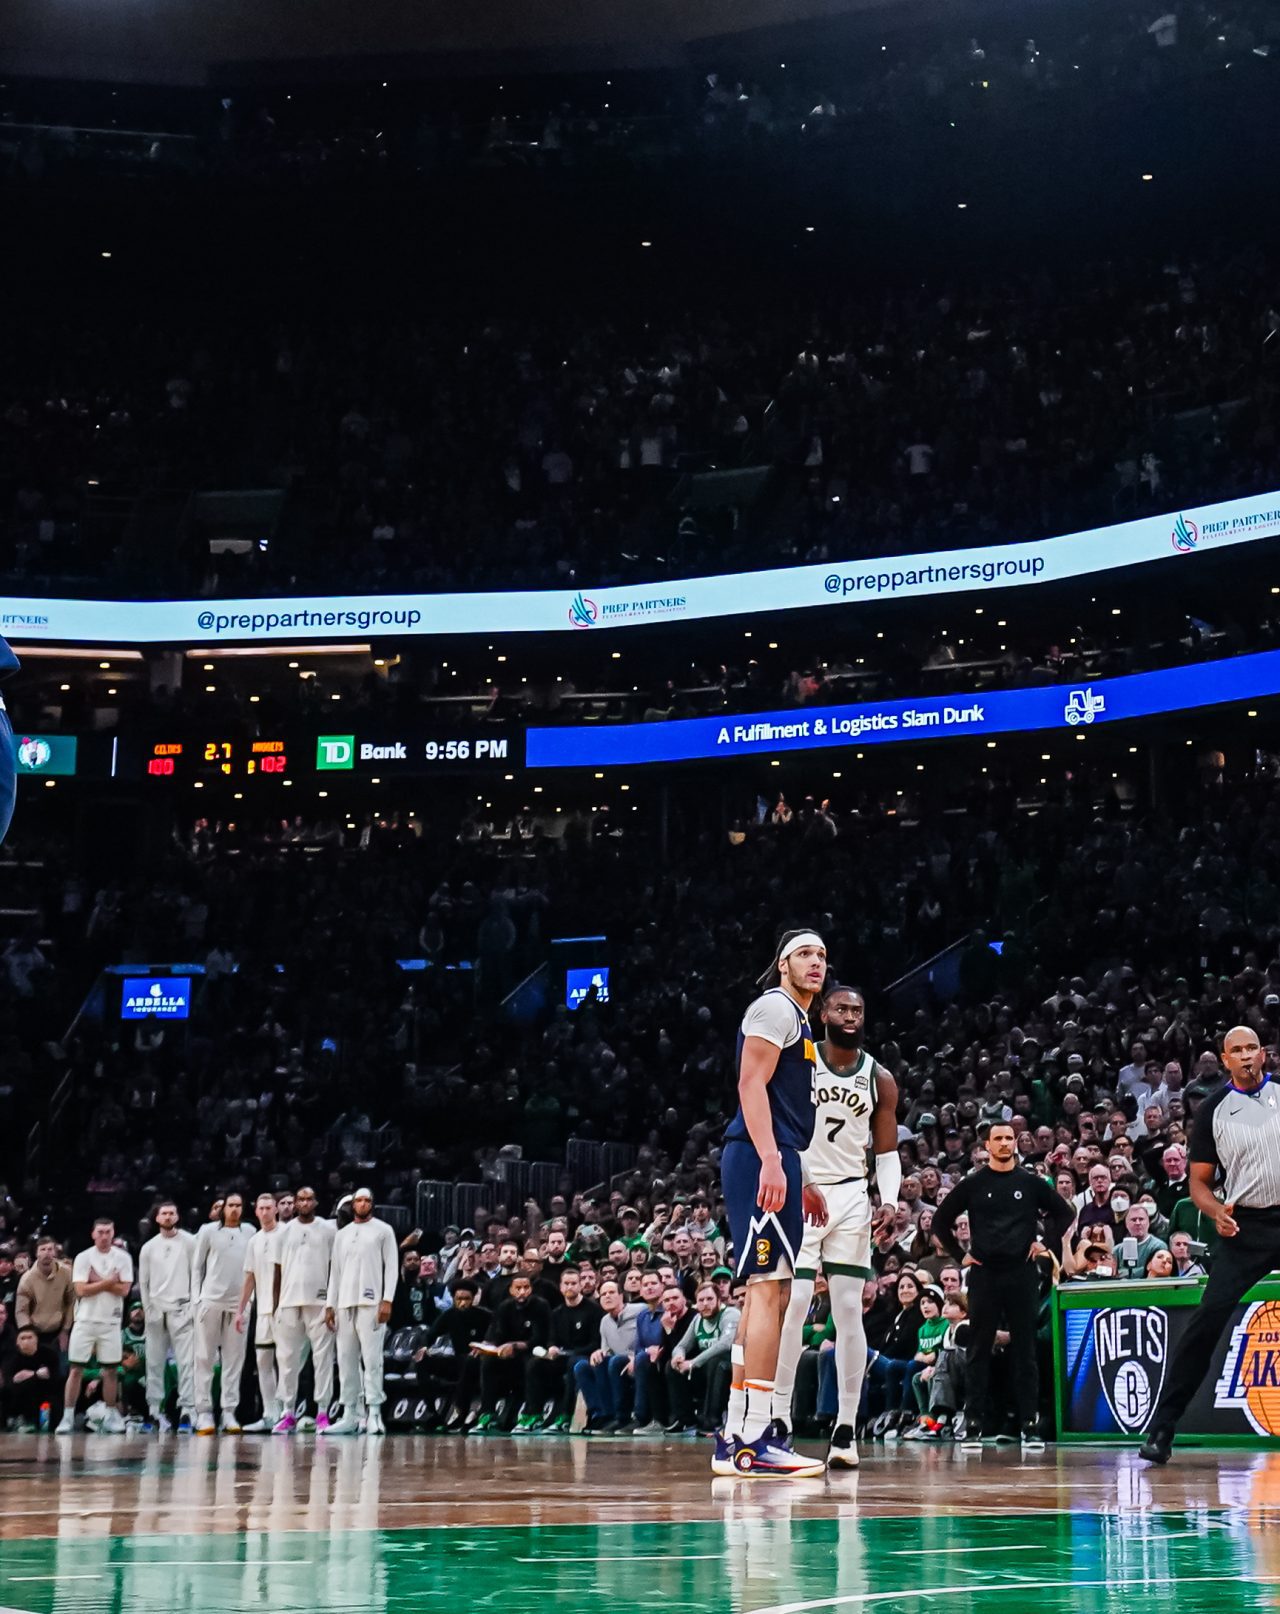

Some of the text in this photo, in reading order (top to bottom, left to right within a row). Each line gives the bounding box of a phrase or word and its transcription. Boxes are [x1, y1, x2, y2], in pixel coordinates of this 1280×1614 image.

[1202, 521, 1230, 534] PREP
[824, 557, 1045, 596] @preppartnersgroup
[602, 597, 686, 614] PREP PARTNERS
[2, 614, 49, 625] RTNERS
[197, 608, 421, 633] @preppartnersgroup
[717, 704, 985, 744] A Fulfillment & Logistics Slam Dunk
[204, 743, 232, 760] 2.7
[320, 741, 407, 763] TD Bank
[425, 739, 508, 760] 9:56 PM
[261, 756, 287, 773] 102
[815, 1085, 869, 1118] OSTON
[824, 1116, 846, 1143] 7
[1100, 1308, 1163, 1367] NETS
[1257, 1331, 1280, 1343] LOS
[1126, 1370, 1139, 1418] B
